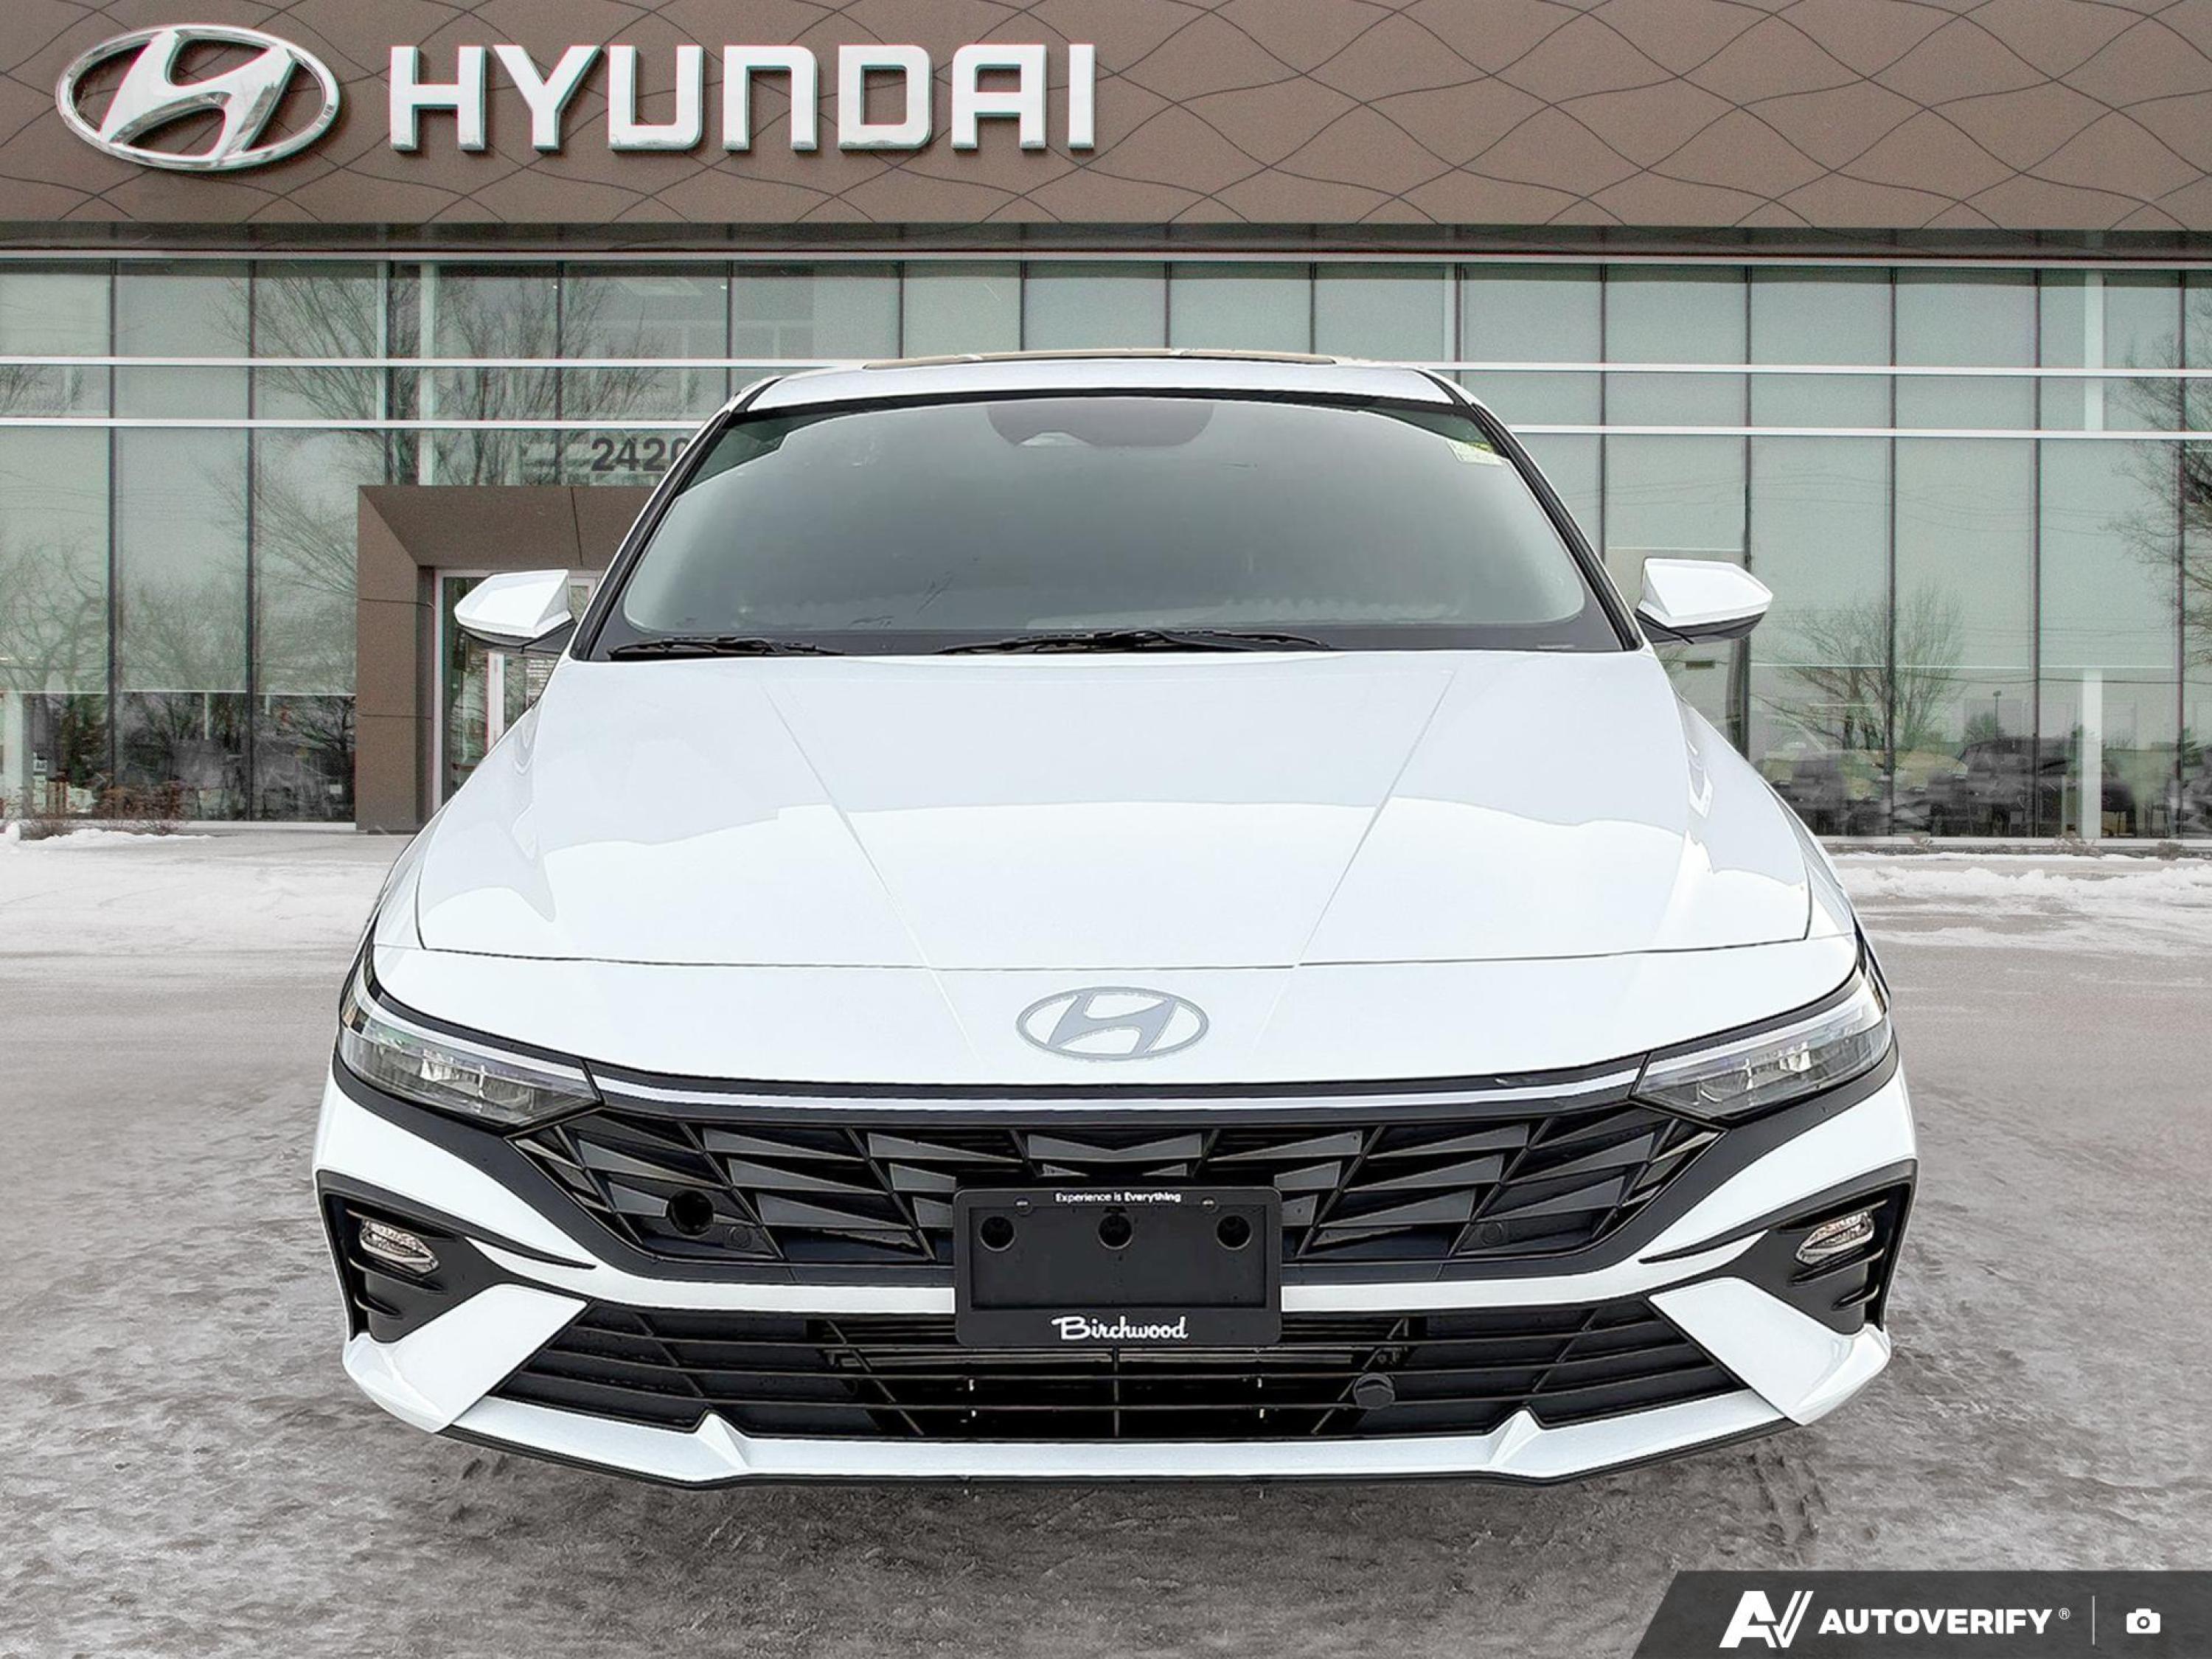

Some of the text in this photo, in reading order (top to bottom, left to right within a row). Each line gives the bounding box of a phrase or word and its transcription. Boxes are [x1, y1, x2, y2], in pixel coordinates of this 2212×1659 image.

[389, 43, 1097, 150] HYUNDAI
[1056, 1192, 1181, 1204] Experience is Everything
[1051, 1315, 1189, 1340] Birchwood
